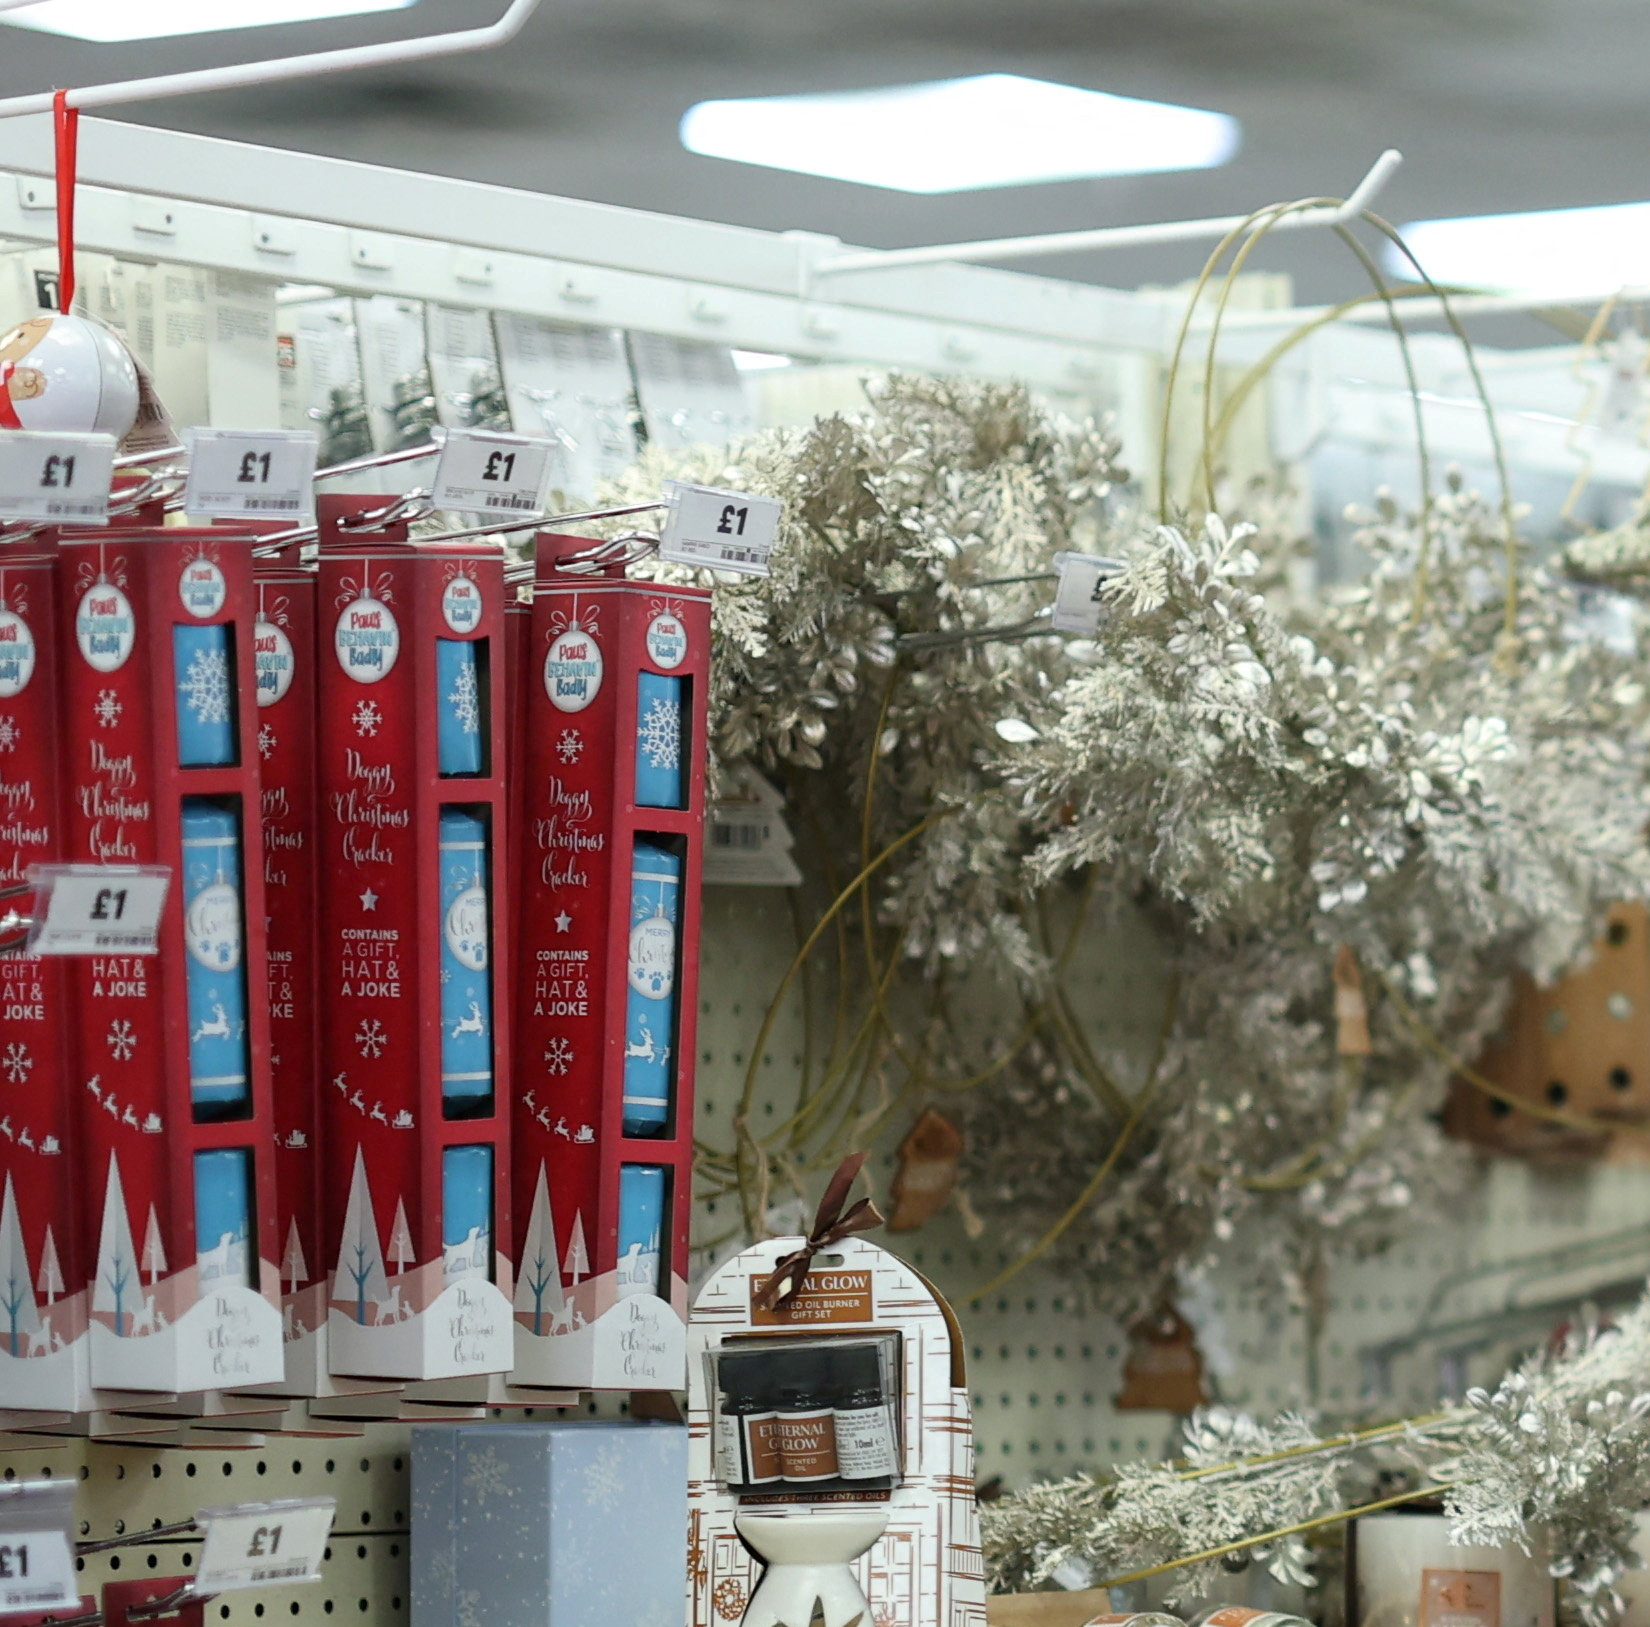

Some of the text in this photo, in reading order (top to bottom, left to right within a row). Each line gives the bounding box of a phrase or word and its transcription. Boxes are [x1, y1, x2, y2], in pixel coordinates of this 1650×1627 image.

[40, 455, 75, 488] £1
[237, 451, 271, 483] £1
[482, 450, 515, 482] £1
[717, 504, 748, 536] £1
[351, 610, 383, 630] Paws
[349, 648, 383, 672] Badly
[559, 643, 587, 661] Paws
[556, 678, 588, 701] Badly
[90, 739, 136, 787] Doggy
[346, 747, 396, 793] Doggy
[78, 783, 149, 820] Christmas
[548, 776, 593, 823] Doggy
[331, 790, 410, 829] Christmas
[532, 817, 606, 852] Christmas
[343, 825, 394, 869] Cracker
[541, 852, 589, 893] Cracker
[90, 888, 128, 920] £1
[341, 928, 399, 941] CONTAINS
[342, 942, 400, 960] A GIFT,
[536, 950, 589, 961] CONTAINS
[2, 964, 43, 980] GIFT,
[92, 959, 146, 979] HAT &
[341, 961, 400, 980] HAT &
[536, 962, 589, 979] A GIFT,
[2, 983, 44, 1001] AT &
[93, 981, 147, 998] A JOKE
[280, 982, 293, 1000] &
[341, 981, 401, 998] A JOKE
[535, 980, 589, 999] HAT &
[4, 1004, 45, 1020] JOKE
[534, 1001, 589, 1017] A JOKE
[821, 1274, 868, 1291] GLOW
[805, 1300, 820, 1310] OIL
[821, 1299, 860, 1309] BURNER
[791, 1309, 832, 1320] GIFT SET
[782, 1437, 820, 1451] GLOW
[786, 1457, 817, 1465] SCENTED
[864, 1491, 886, 1500] OILS
[246, 1525, 283, 1557] £1
